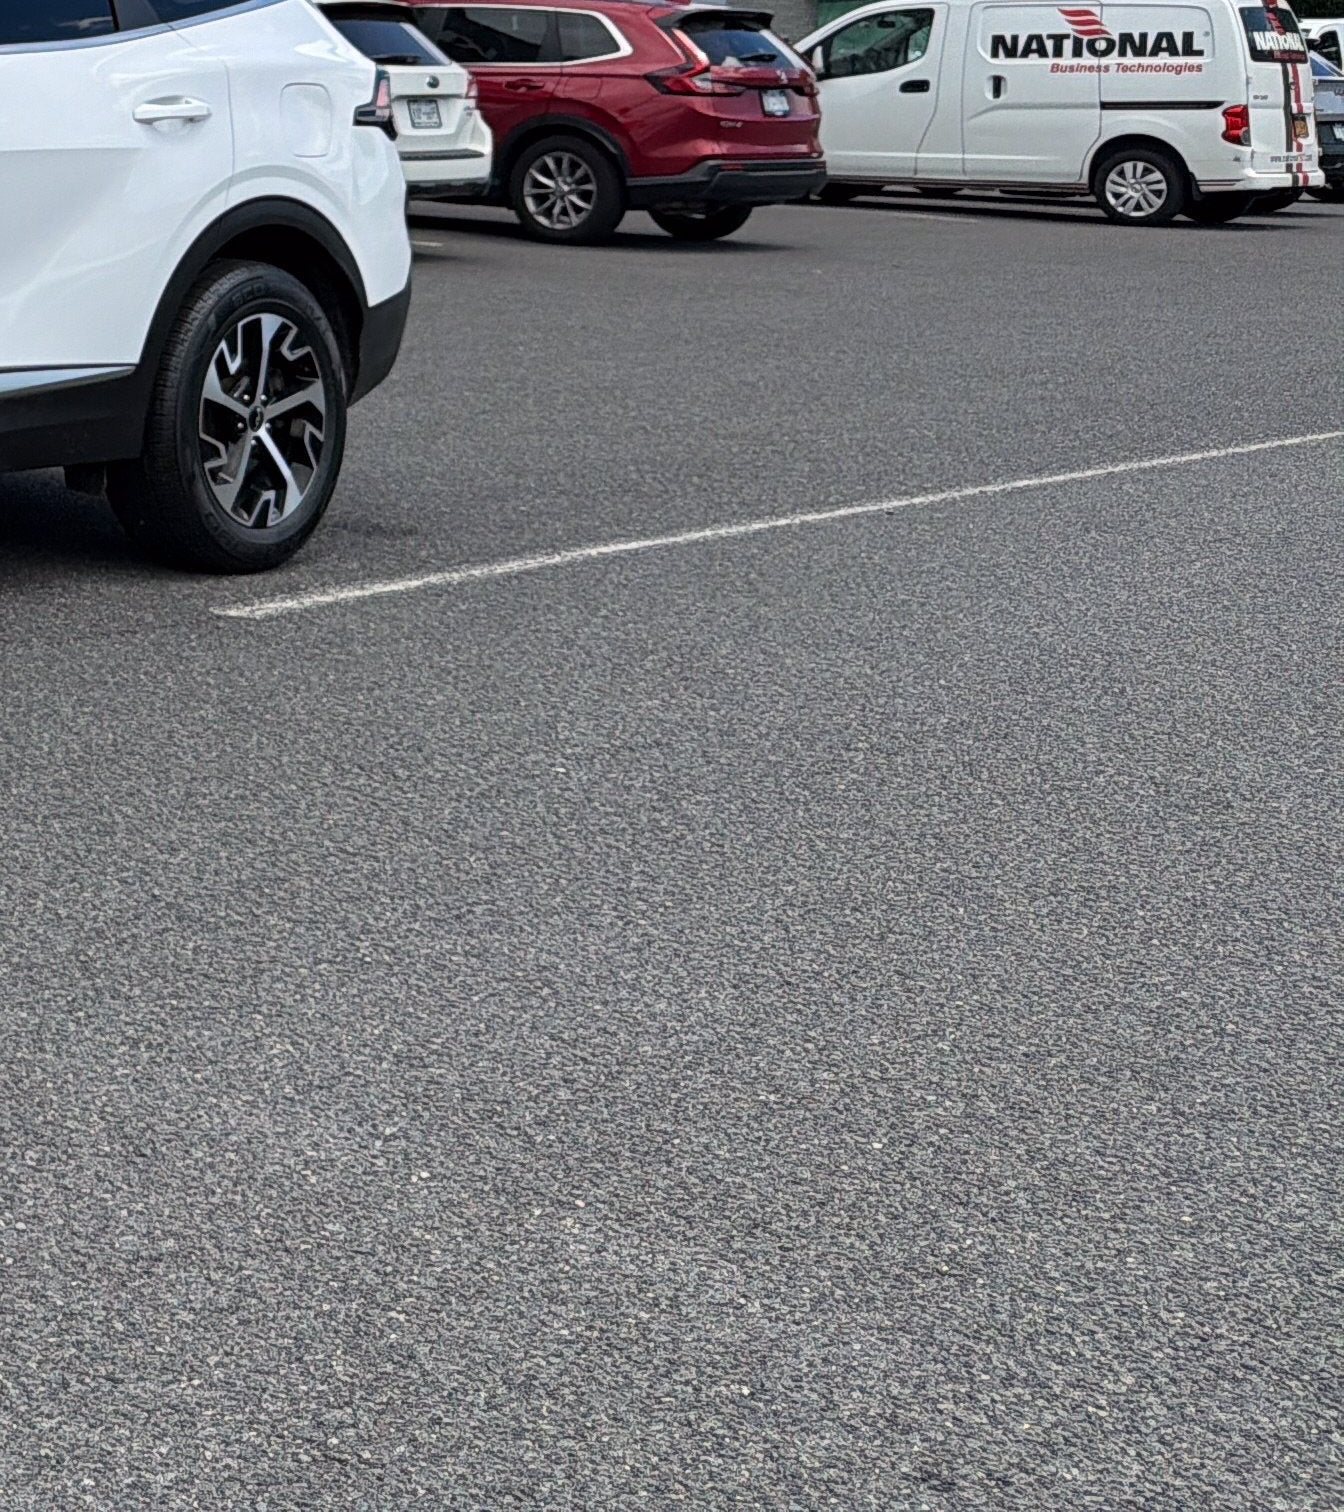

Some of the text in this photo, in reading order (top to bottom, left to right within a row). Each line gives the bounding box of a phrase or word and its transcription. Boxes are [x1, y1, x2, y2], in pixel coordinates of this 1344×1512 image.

[990, 30, 1205, 59] NATIONAL
[1049, 61, 1204, 76] Business Technologies
